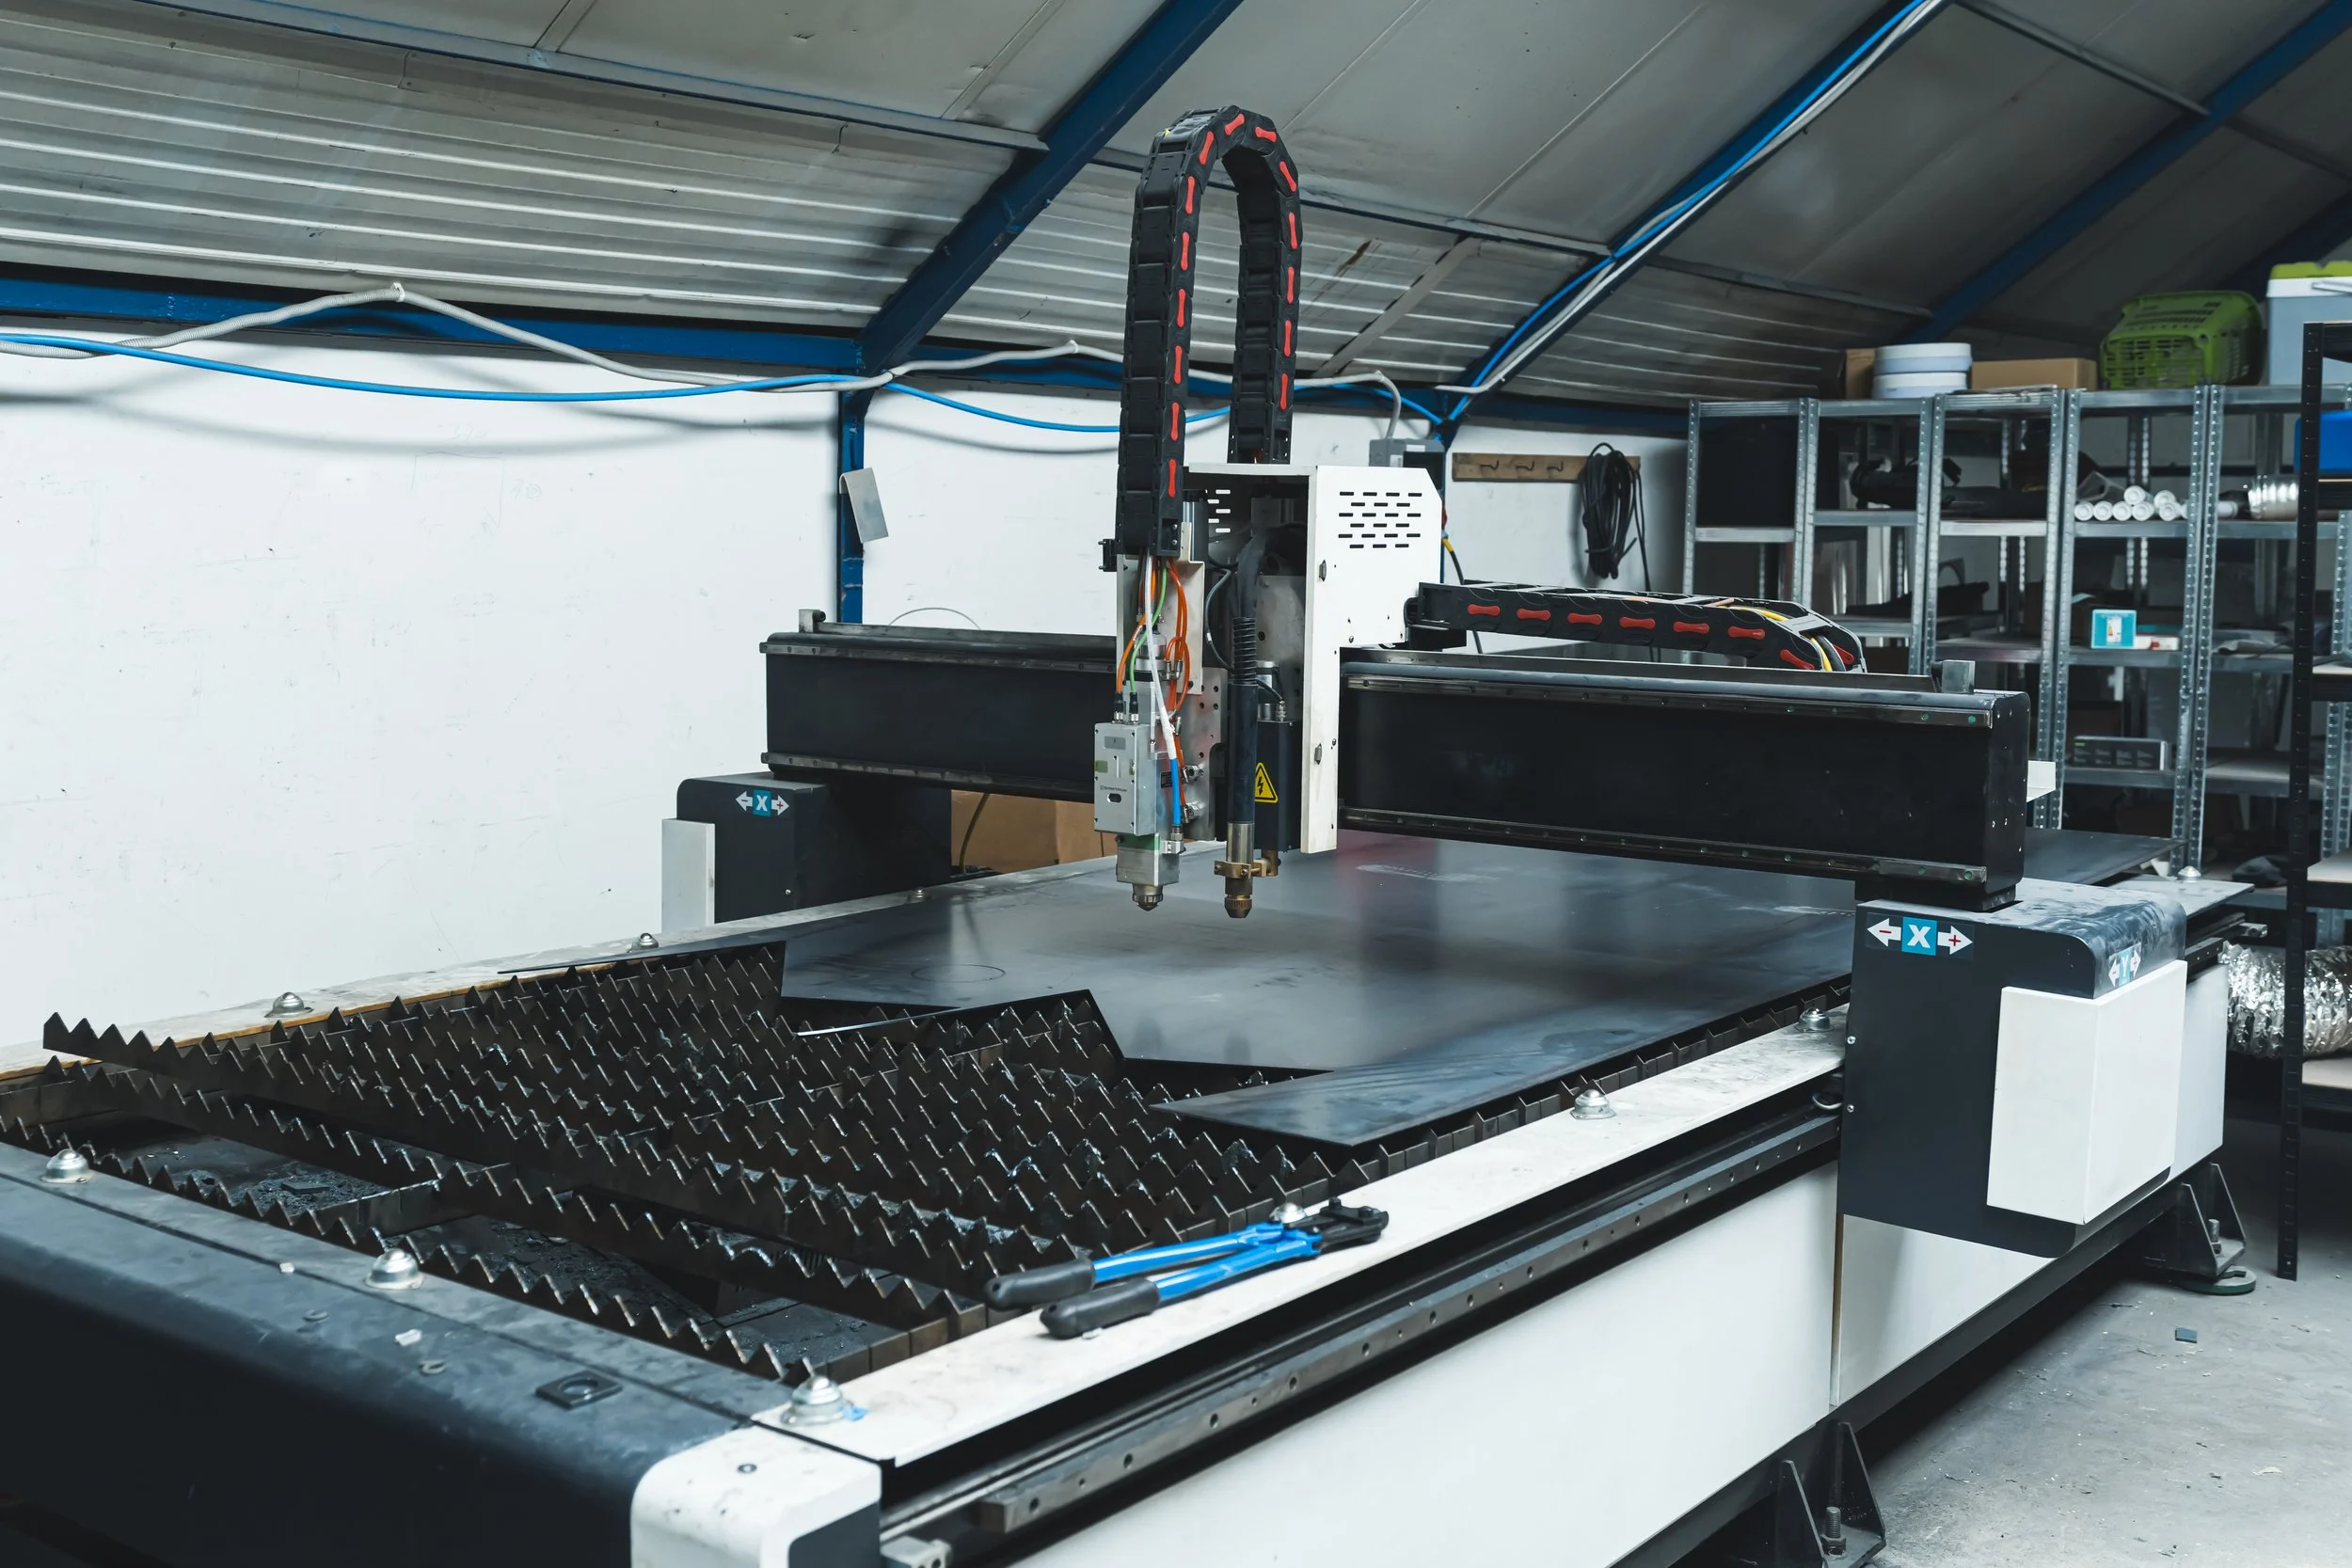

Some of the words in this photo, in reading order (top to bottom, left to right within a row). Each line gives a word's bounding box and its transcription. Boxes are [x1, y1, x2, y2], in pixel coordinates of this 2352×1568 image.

[755, 794, 769, 812] X
[1907, 924, 1931, 948] X
[2122, 954, 2129, 977] Y
